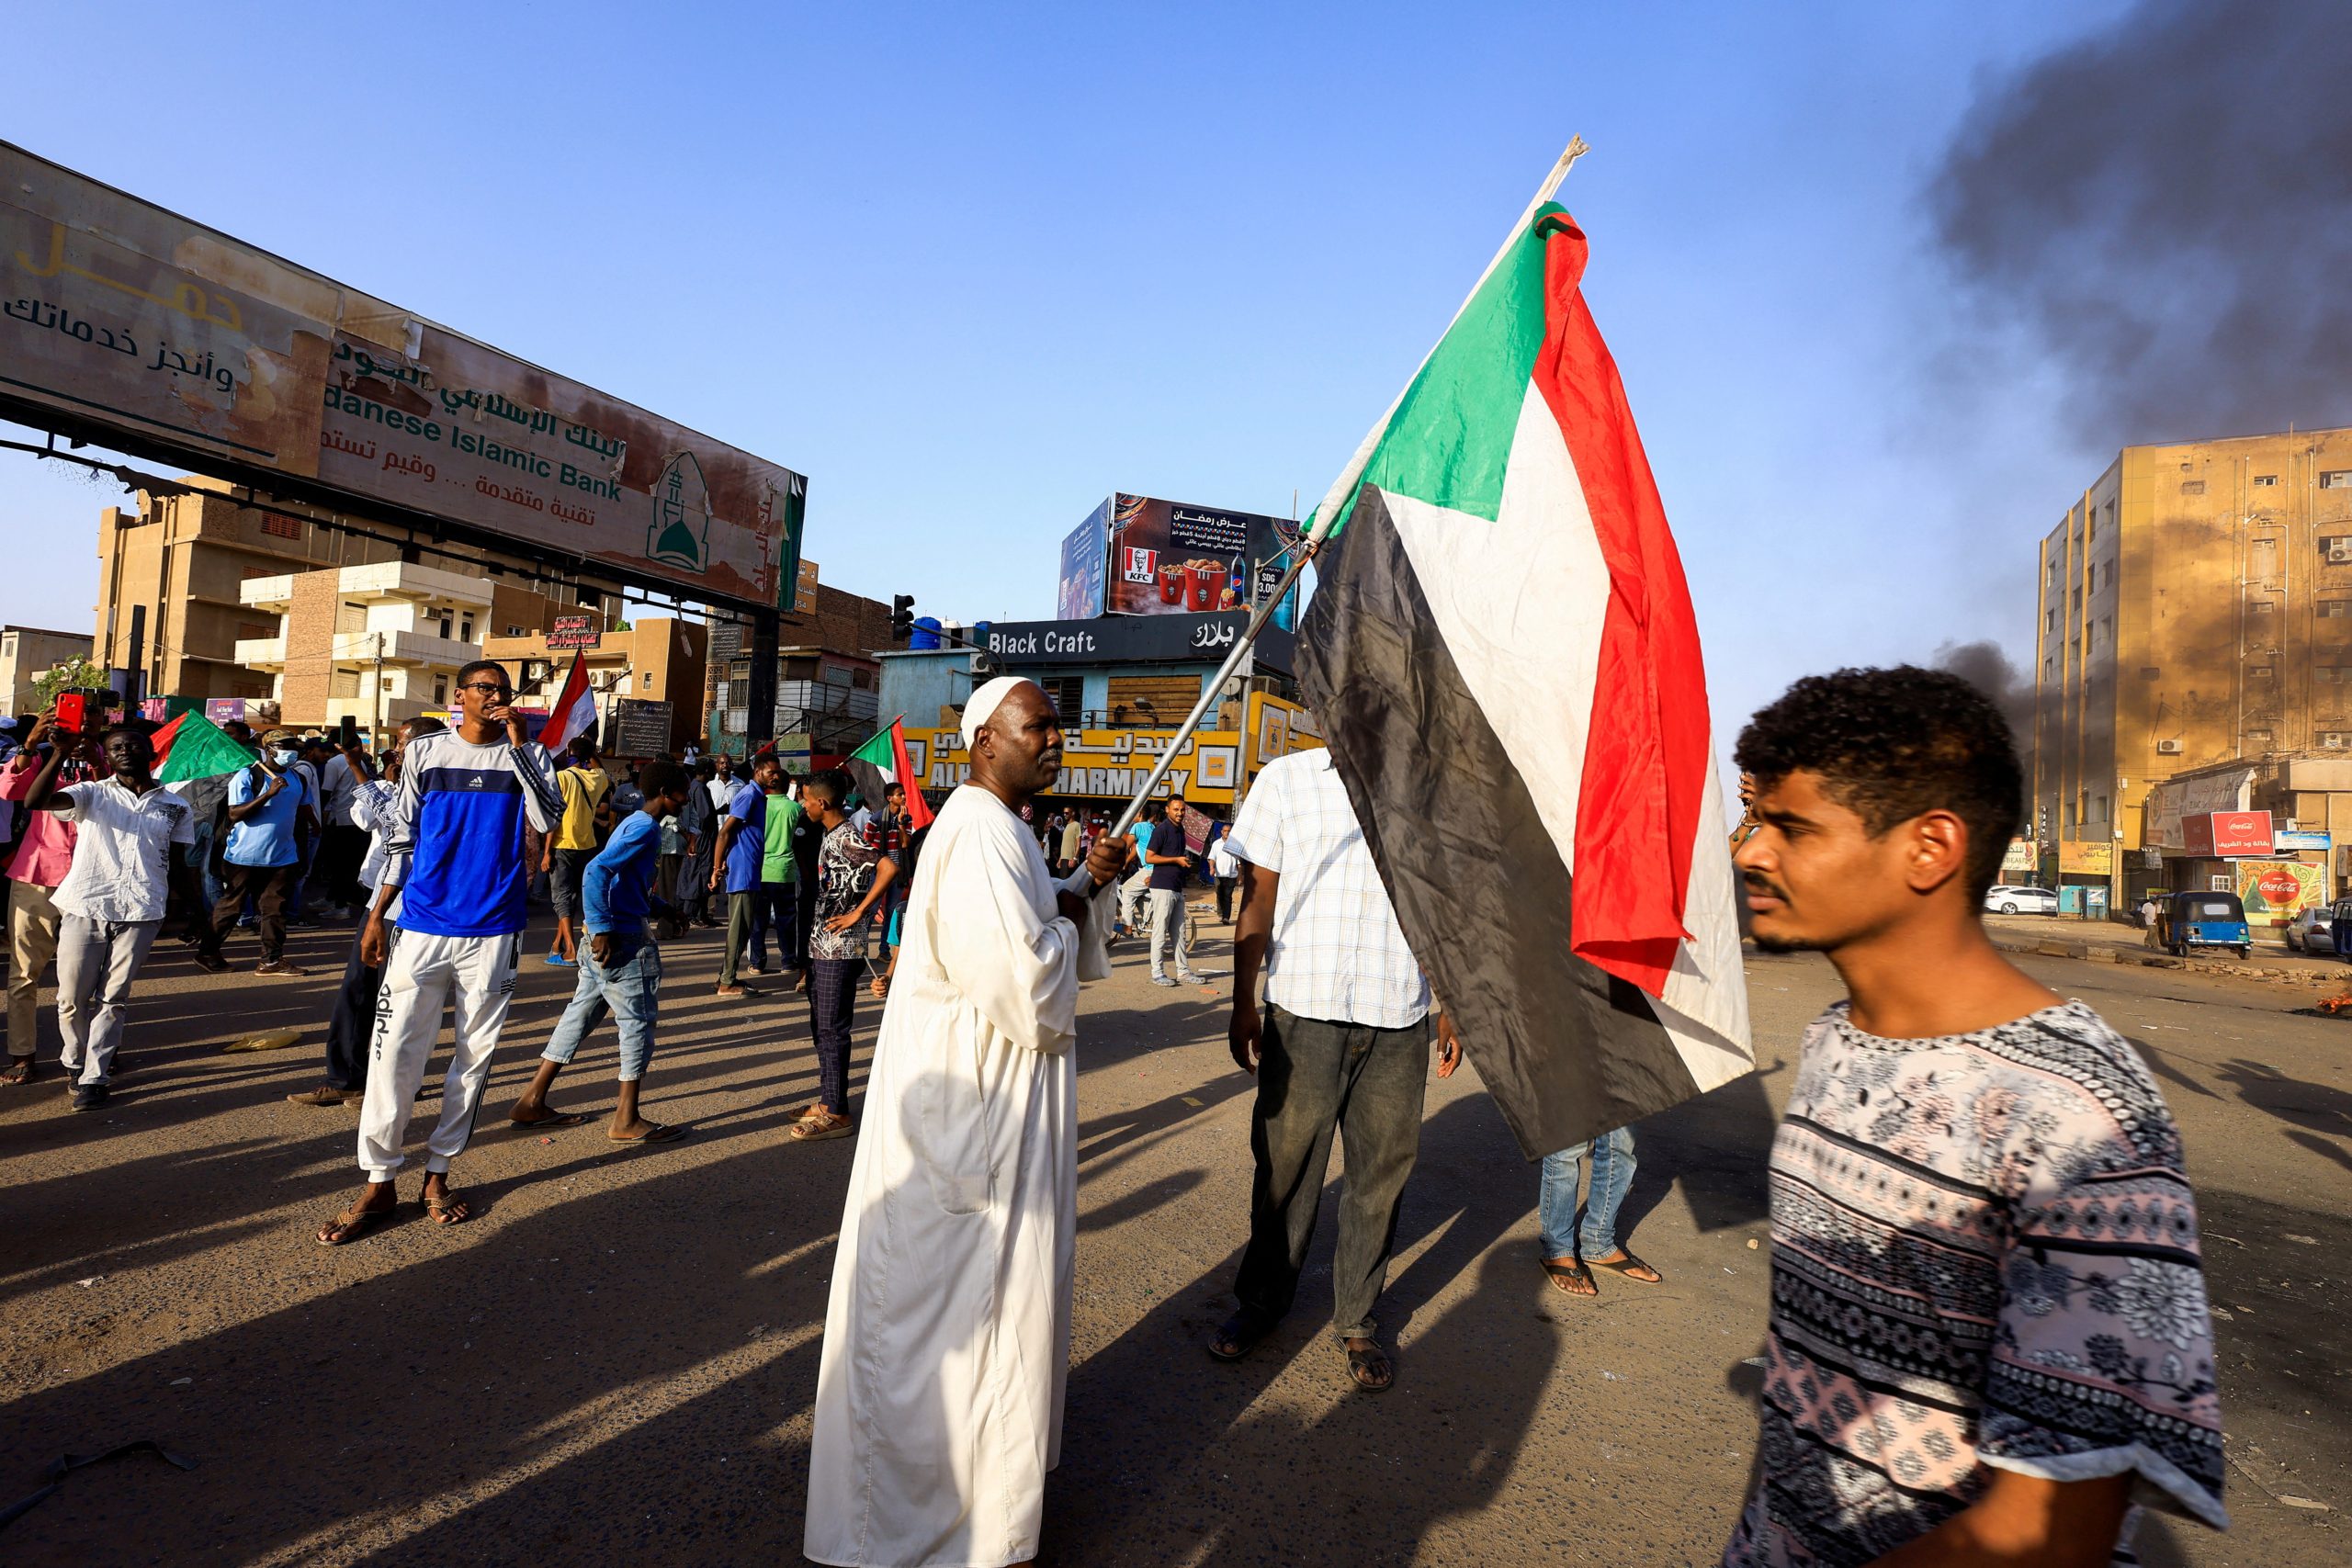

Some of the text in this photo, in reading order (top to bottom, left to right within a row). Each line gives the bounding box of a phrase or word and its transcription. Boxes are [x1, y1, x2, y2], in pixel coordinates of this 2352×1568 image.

[4, 299, 233, 393] وأنجز خدماتك
[565, 424, 622, 461] لبنك
[382, 451, 436, 482] وقيم
[451, 425, 551, 479] Islamic
[560, 462, 622, 503] Bank
[475, 475, 544, 512] متقدمة
[550, 499, 595, 525] تقنية
[1173, 511, 1247, 528] عرض رمضان
[1129, 572, 1149, 582] KFC
[1259, 582, 1278, 593] 3,00
[1261, 572, 1275, 583] SDG
[989, 630, 1096, 654] Black Craft
[1191, 620, 1234, 648] بلاك
[1052, 766, 1192, 798] HARMACY
[2217, 840, 2242, 849] الشريف
